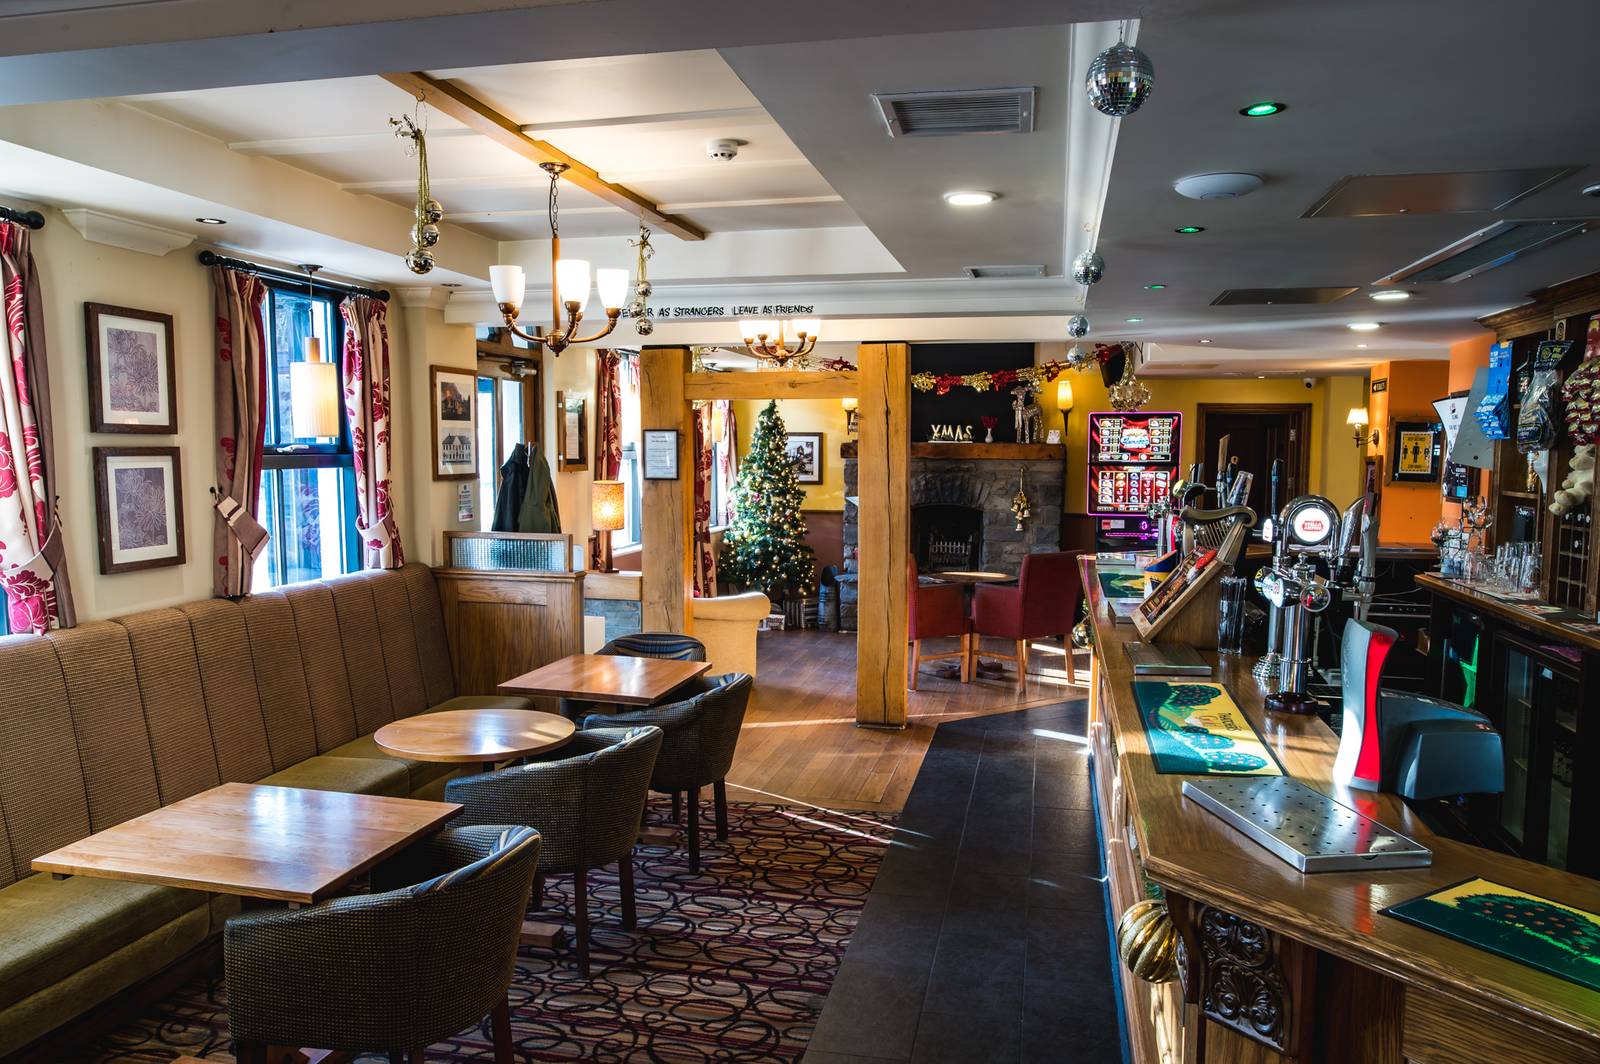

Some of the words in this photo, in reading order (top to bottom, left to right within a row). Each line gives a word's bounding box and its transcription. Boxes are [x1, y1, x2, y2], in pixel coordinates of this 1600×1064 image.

[659, 307, 671, 317] AS
[674, 306, 725, 317] STRANGERS
[733, 305, 759, 316] LEAVE
[762, 304, 773, 315] AS
[775, 304, 814, 314] FRIENDS
[931, 424, 973, 441] XMAS
